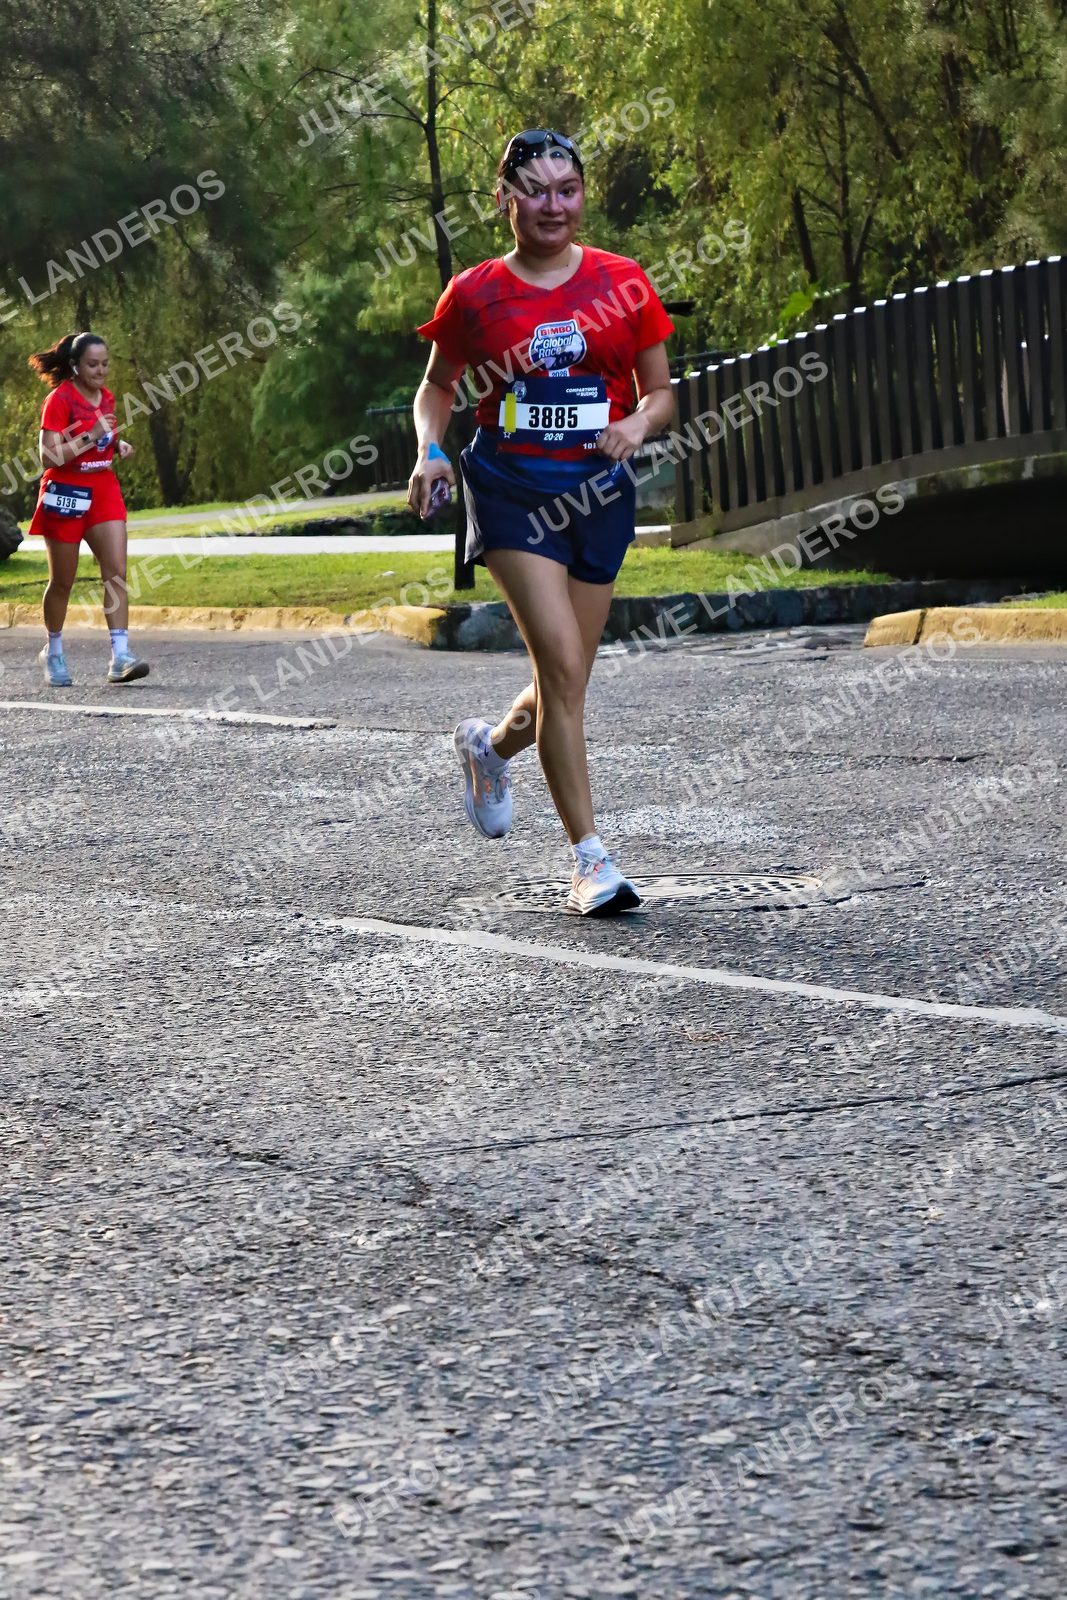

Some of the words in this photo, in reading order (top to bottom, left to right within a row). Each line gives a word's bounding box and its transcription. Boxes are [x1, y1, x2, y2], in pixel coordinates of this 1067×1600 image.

[543, 335, 573, 349] Global
[538, 347, 562, 359] Race
[528, 406, 578, 428] 3885
[56, 497, 77, 509] 5136
